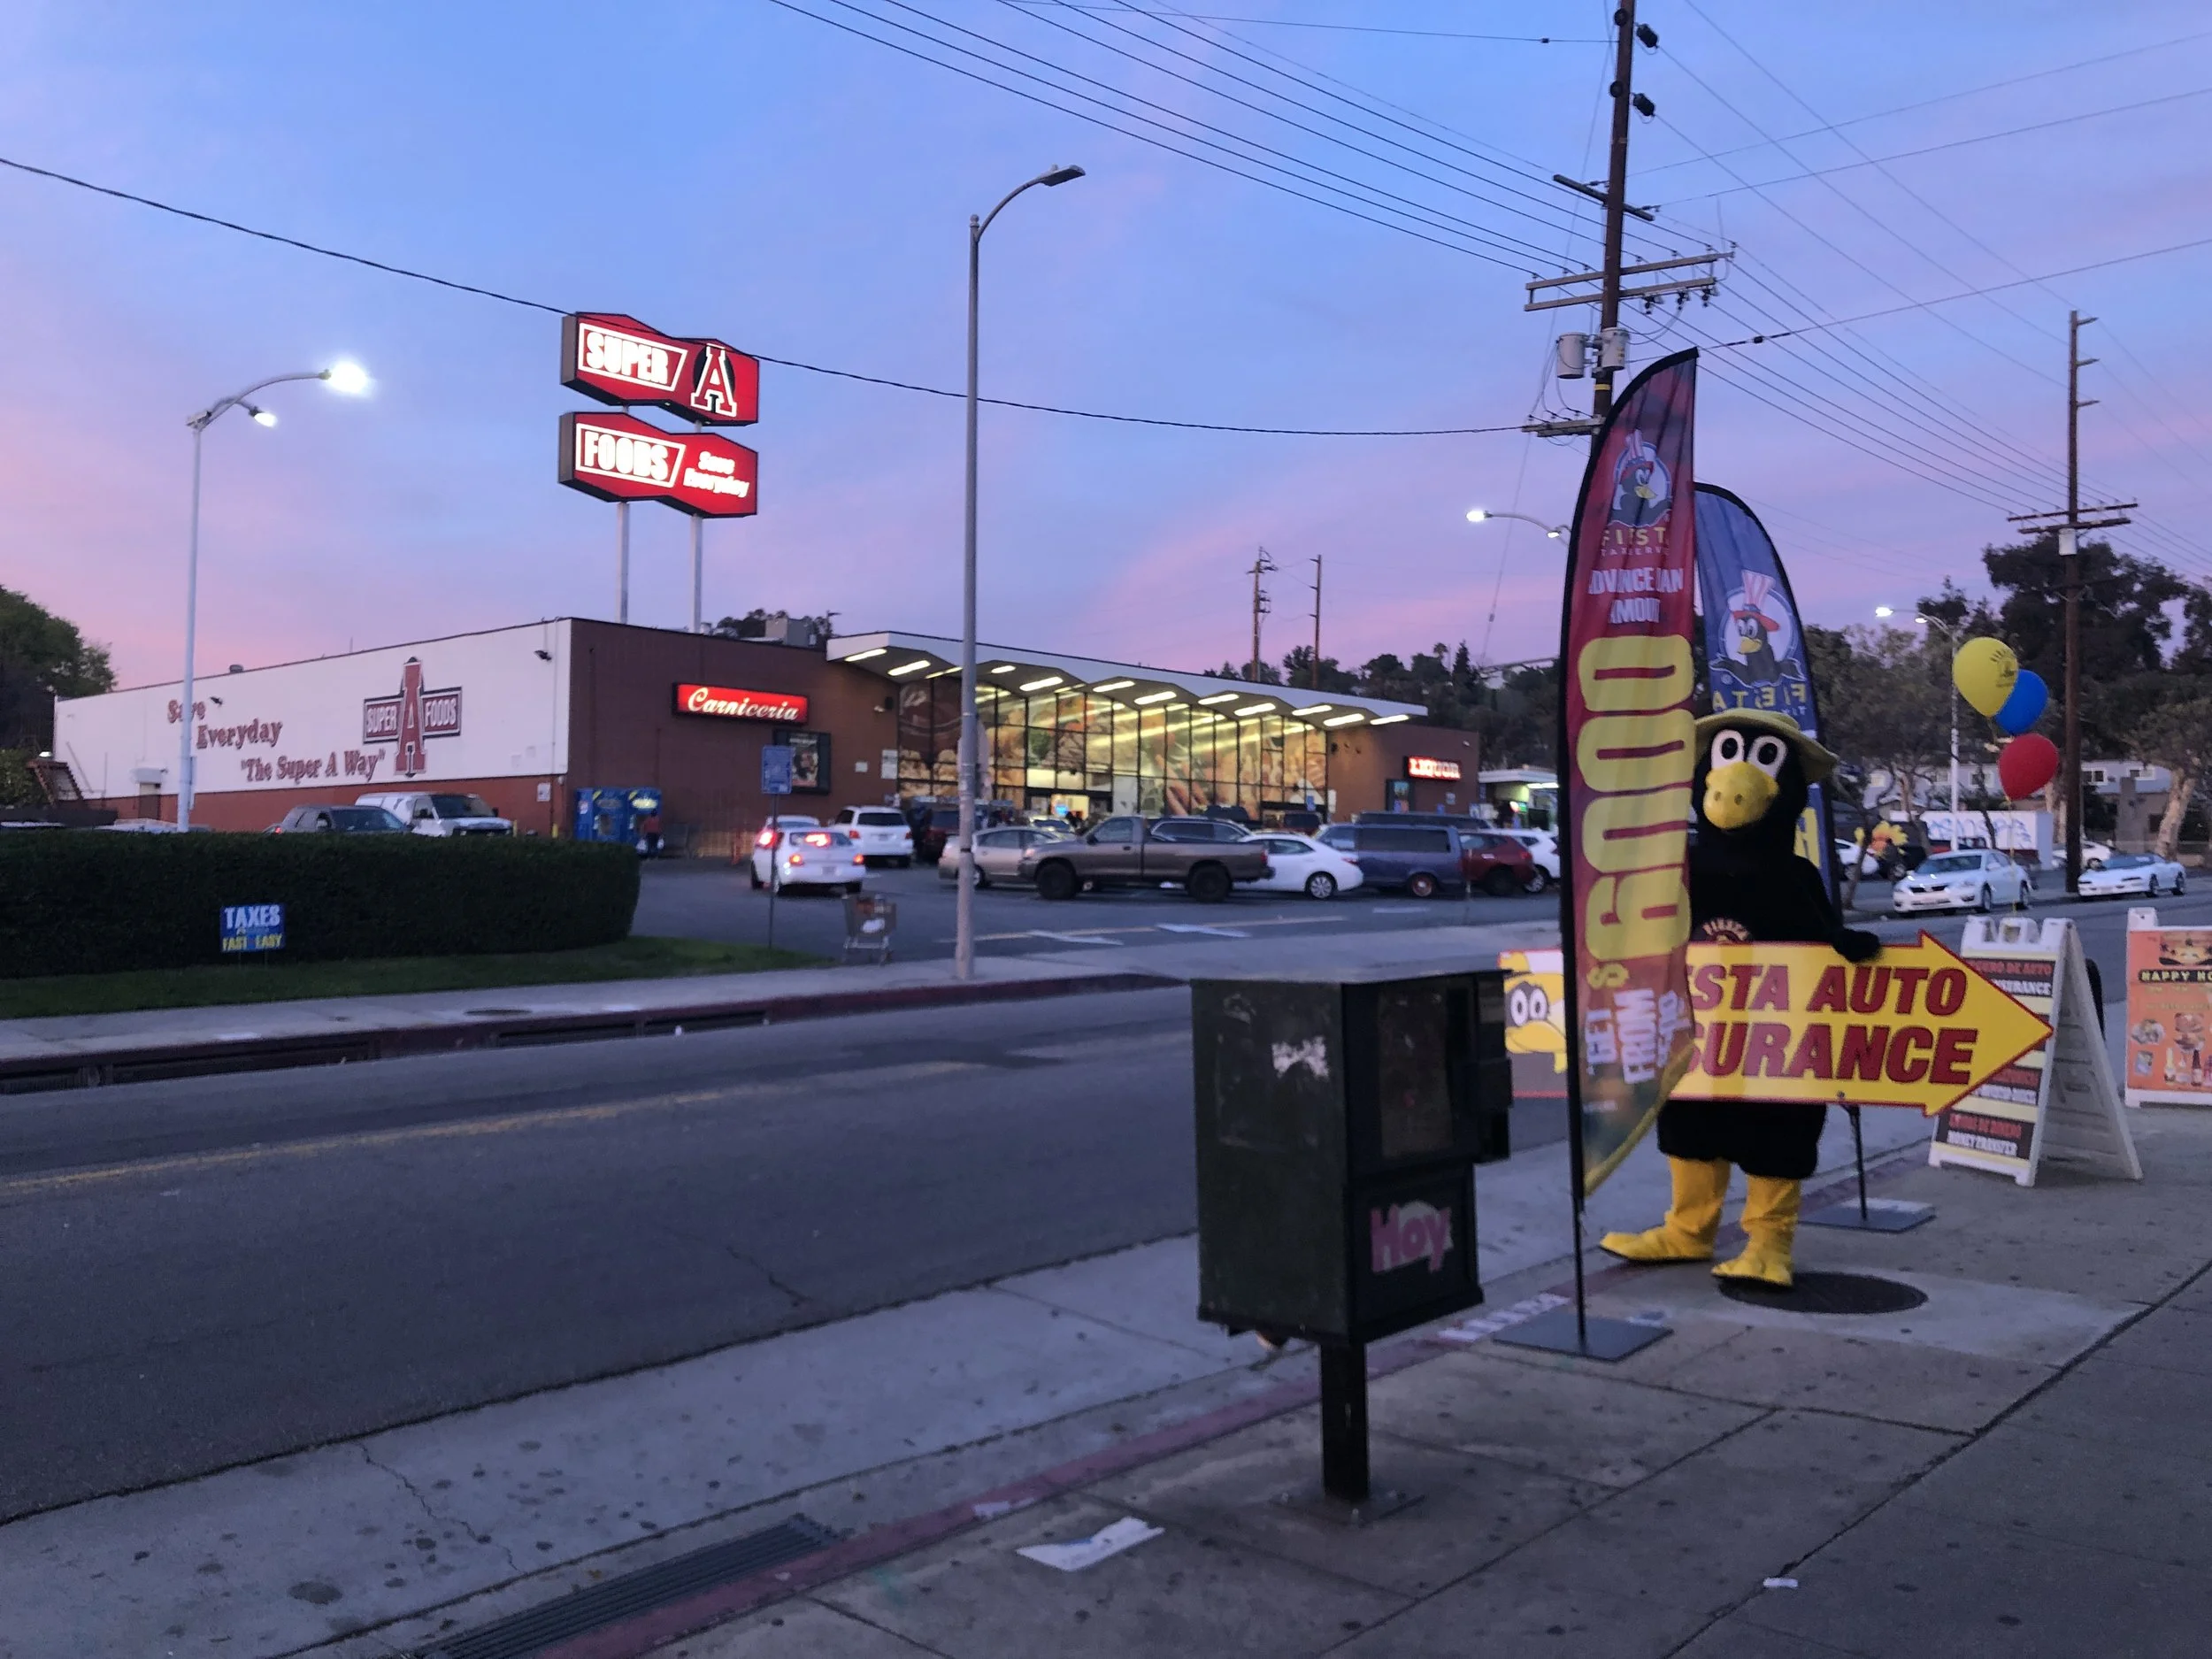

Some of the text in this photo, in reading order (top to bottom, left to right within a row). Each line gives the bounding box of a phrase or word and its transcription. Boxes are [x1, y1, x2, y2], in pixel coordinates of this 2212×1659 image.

[586, 332, 737, 417] SUPER A
[584, 430, 669, 481] FOODS
[367, 705, 397, 733] SUPER
[425, 698, 457, 727] FOODS
[687, 687, 800, 720] Carniceria
[196, 718, 283, 750] Everyday
[277, 755, 322, 785] Super
[325, 751, 338, 778] A
[224, 904, 280, 930] TAXES
[1686, 964, 1968, 1017] STA AUTO
[2141, 970, 2191, 982] HAPPY
[1370, 1202, 1453, 1272] Hoy
